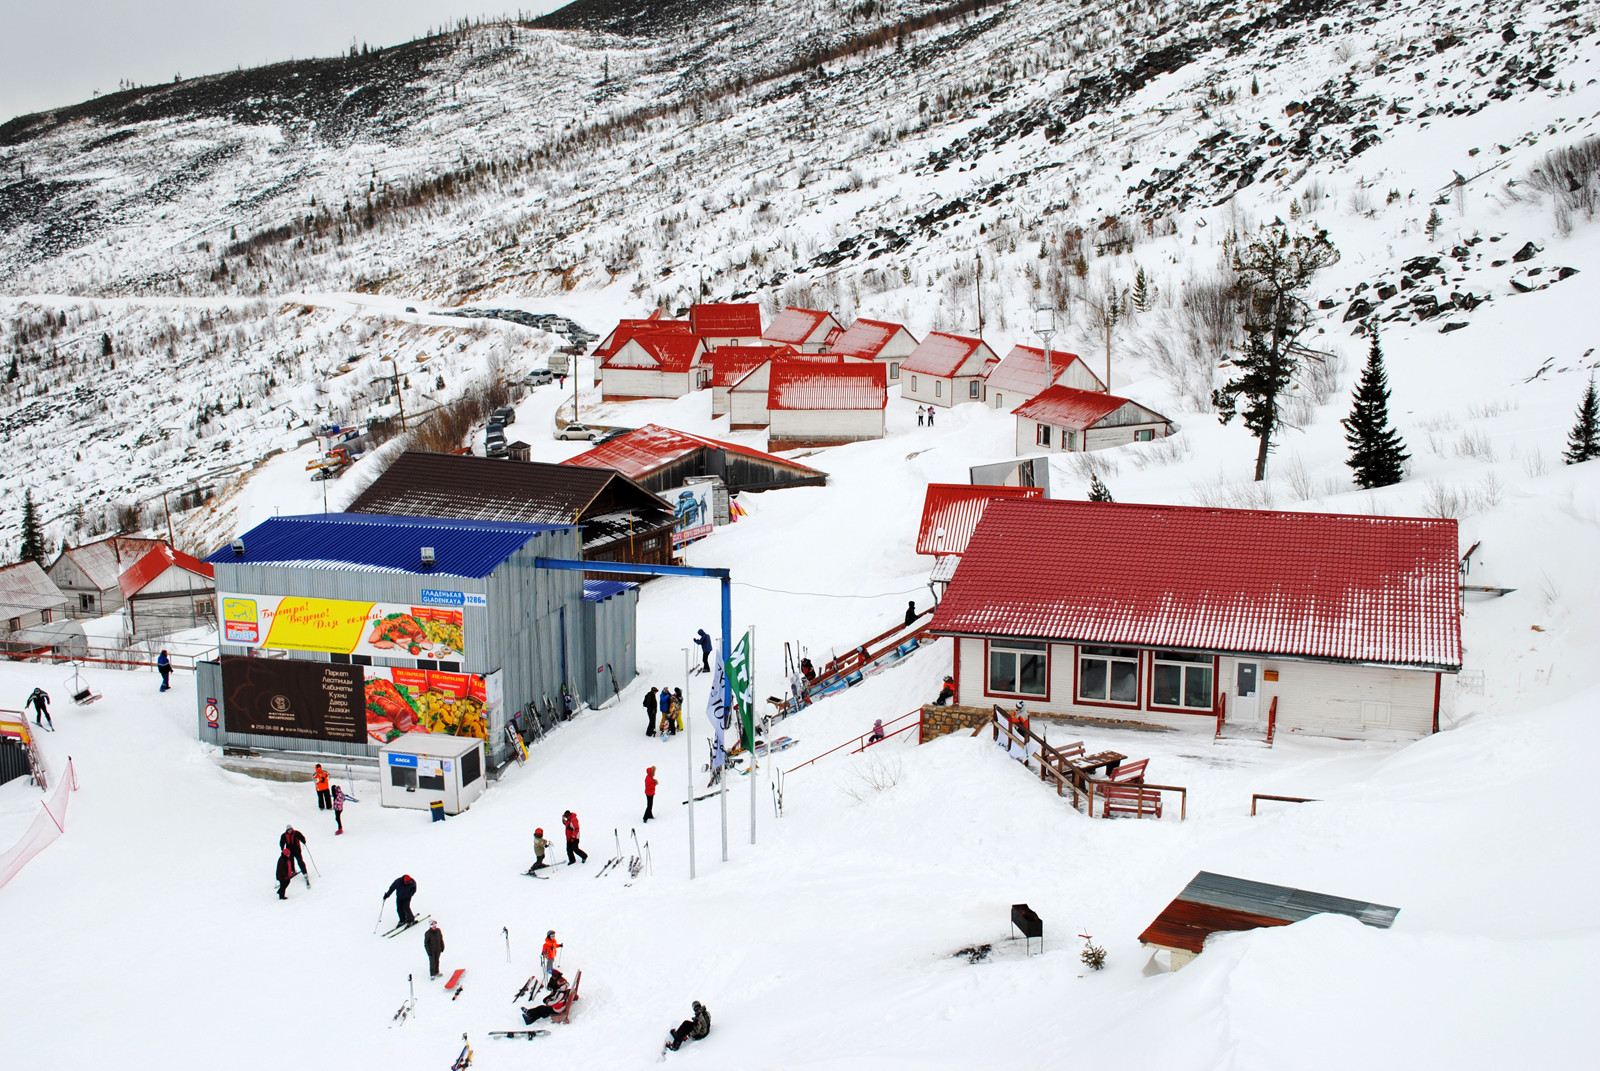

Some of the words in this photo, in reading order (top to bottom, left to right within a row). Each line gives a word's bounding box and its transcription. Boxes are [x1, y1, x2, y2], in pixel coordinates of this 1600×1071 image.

[422, 590, 462, 598] ГЛАДЕНЬКАЯ
[422, 596, 462, 604] GLADENKAYA
[261, 602, 308, 618] Быстро!
[288, 608, 329, 624] Вкусно!
[313, 620, 338, 629] Для
[324, 668, 349, 677] Паркет
